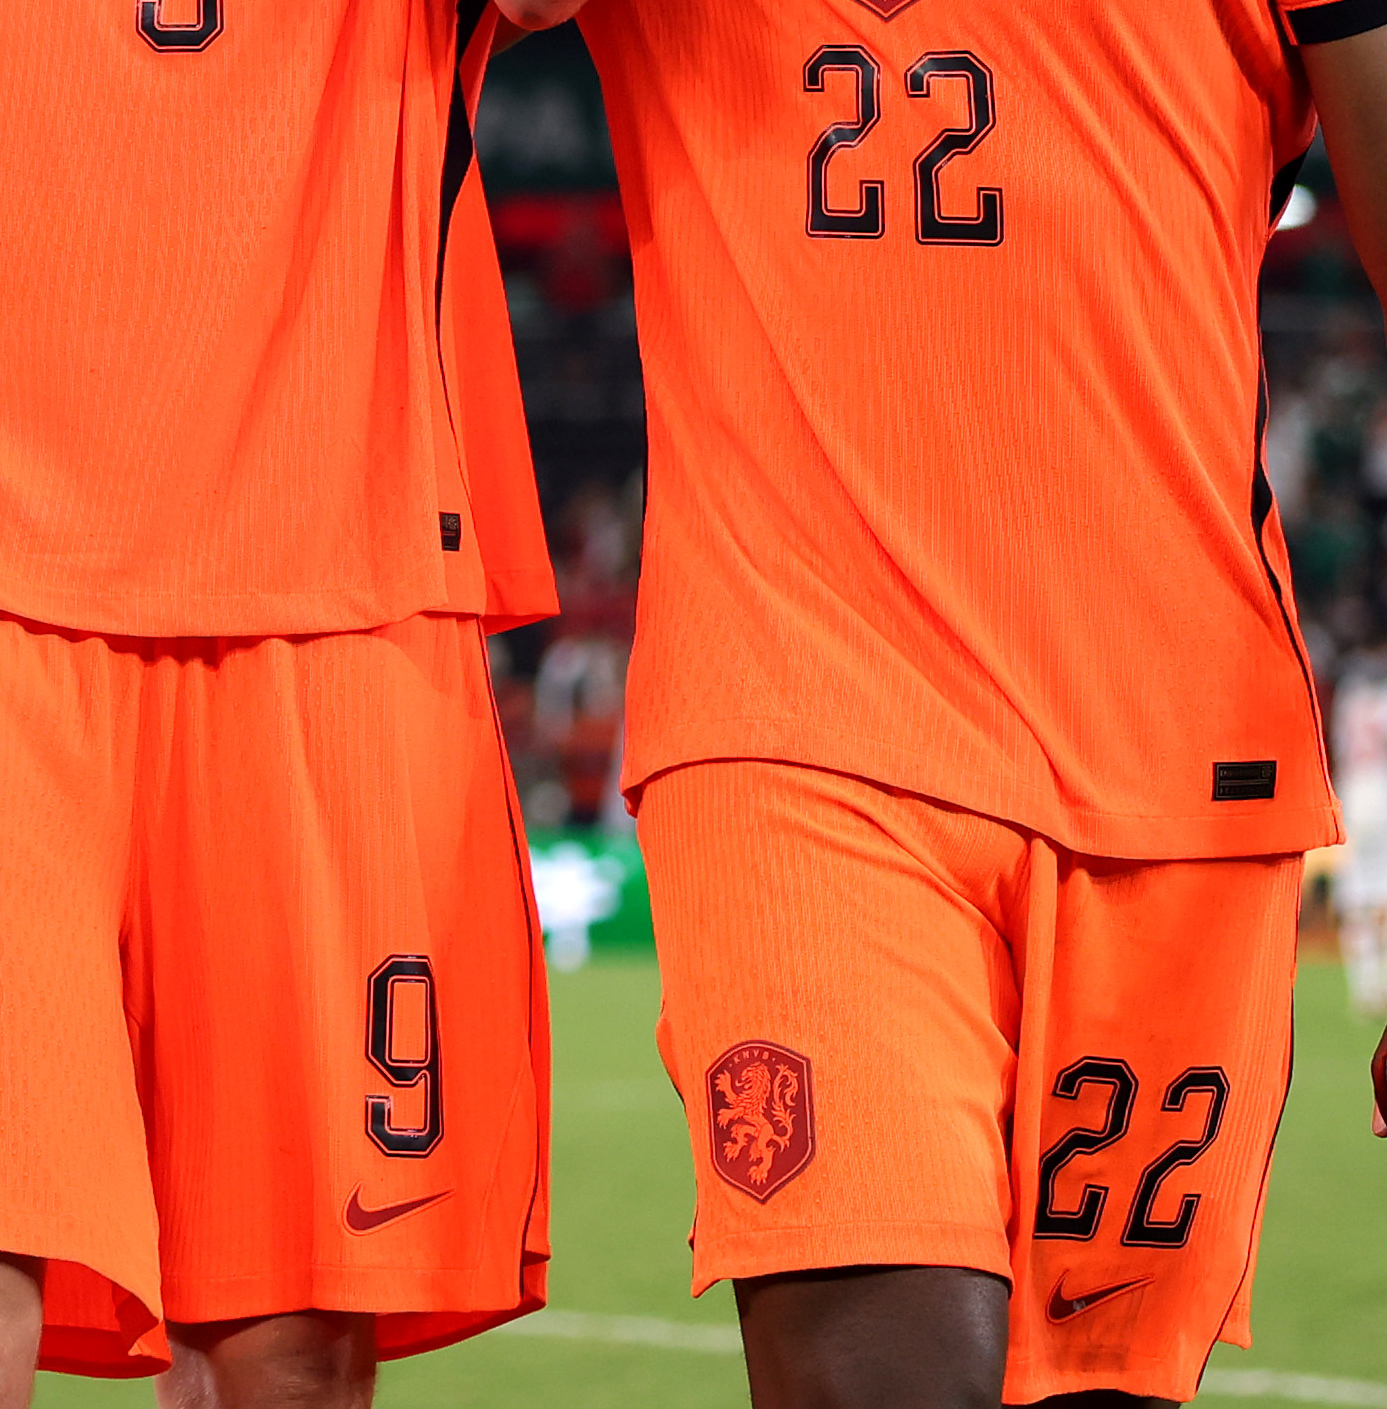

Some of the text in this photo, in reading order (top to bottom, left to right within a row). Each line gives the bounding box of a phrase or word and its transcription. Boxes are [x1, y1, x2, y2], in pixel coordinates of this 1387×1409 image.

[801, 43, 1005, 248] 22
[365, 953, 445, 1159] 9
[733, 1049, 770, 1064] KNVB
[1033, 1054, 1231, 1249] 22
